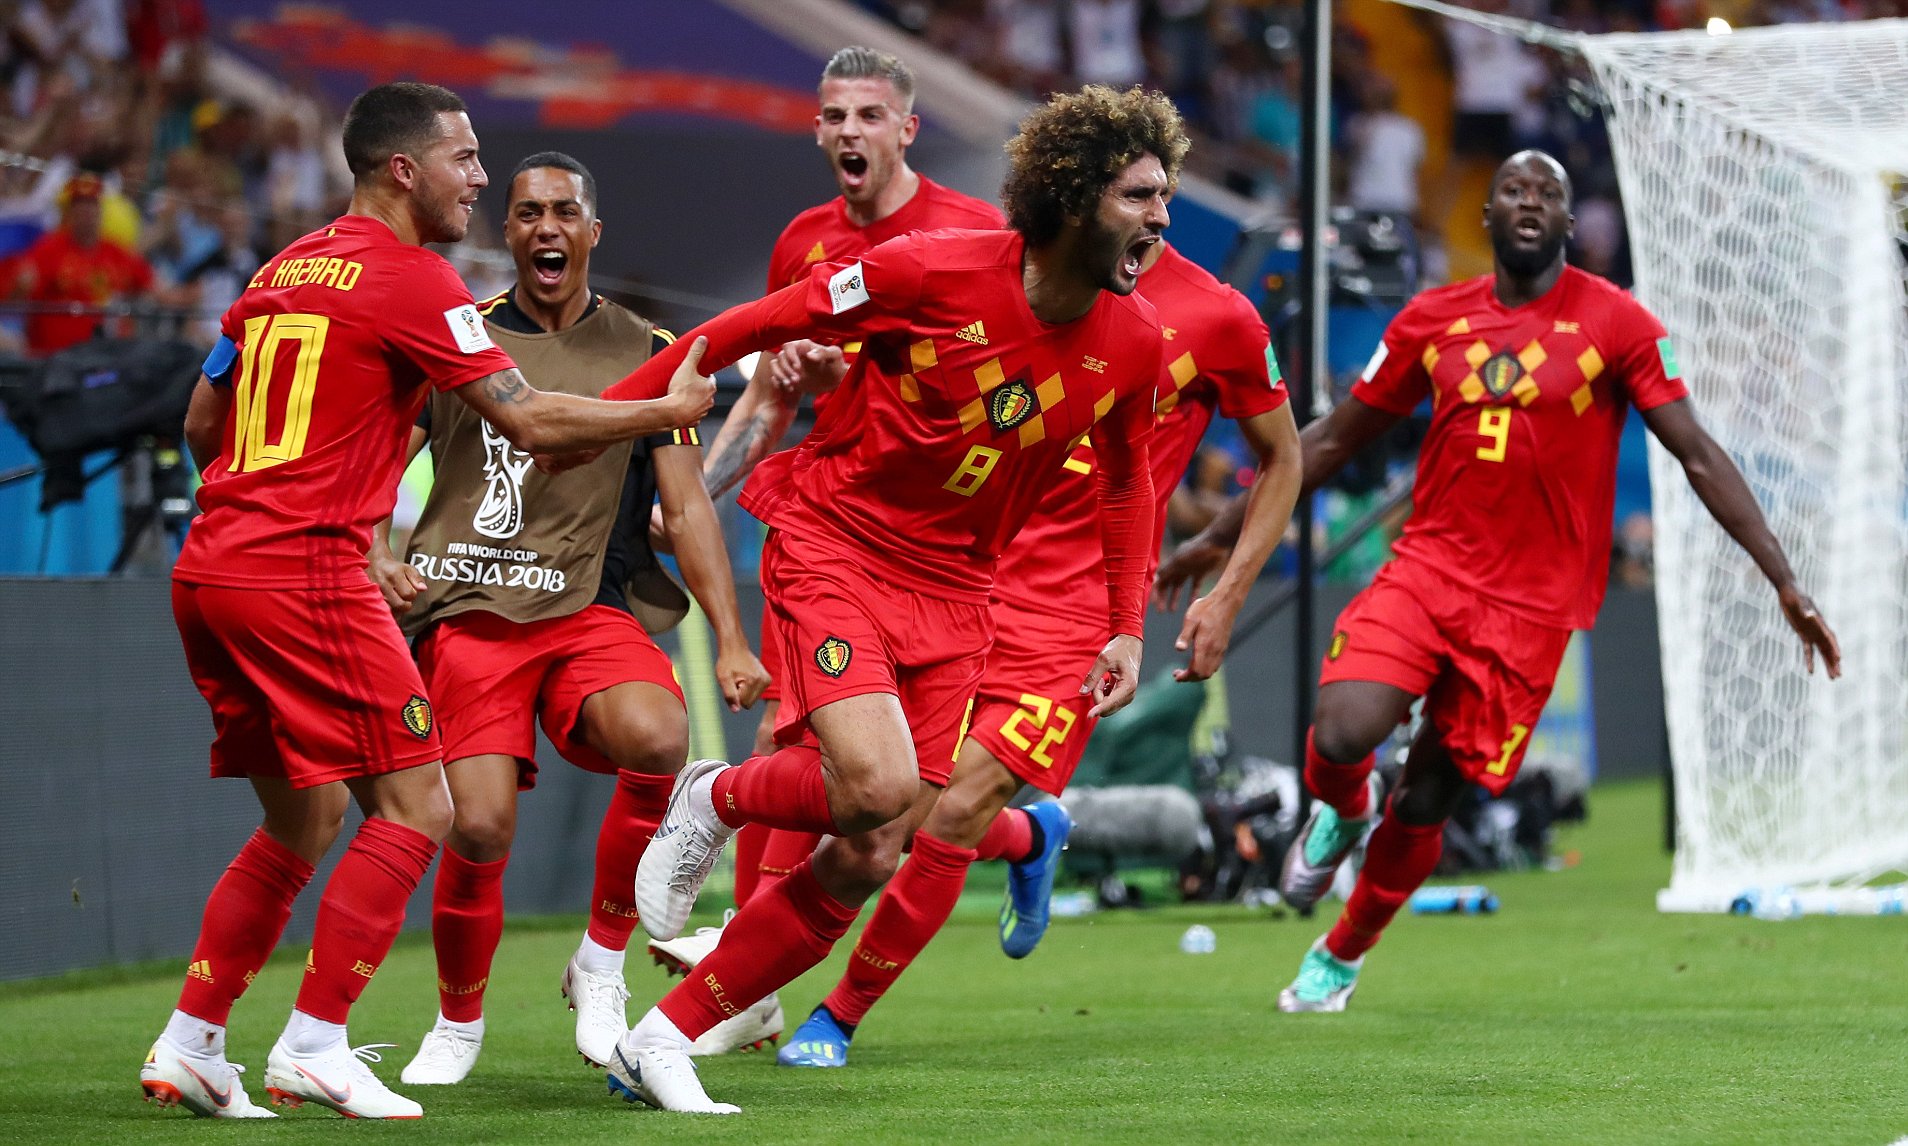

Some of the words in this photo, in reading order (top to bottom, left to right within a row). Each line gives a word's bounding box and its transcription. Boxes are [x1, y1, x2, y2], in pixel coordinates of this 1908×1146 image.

[270, 257, 364, 292] HAZARD
[955, 330, 989, 346] adidas
[227, 313, 330, 473] 10
[1476, 406, 1512, 463] 9
[941, 444, 1003, 497] 8
[410, 553, 503, 586] RUSSIA
[505, 565, 566, 593] 2018
[447, 542, 468, 555] FIFA
[468, 543, 513, 560] WORLD
[513, 550, 539, 563] CUP
[998, 693, 1077, 769] 22
